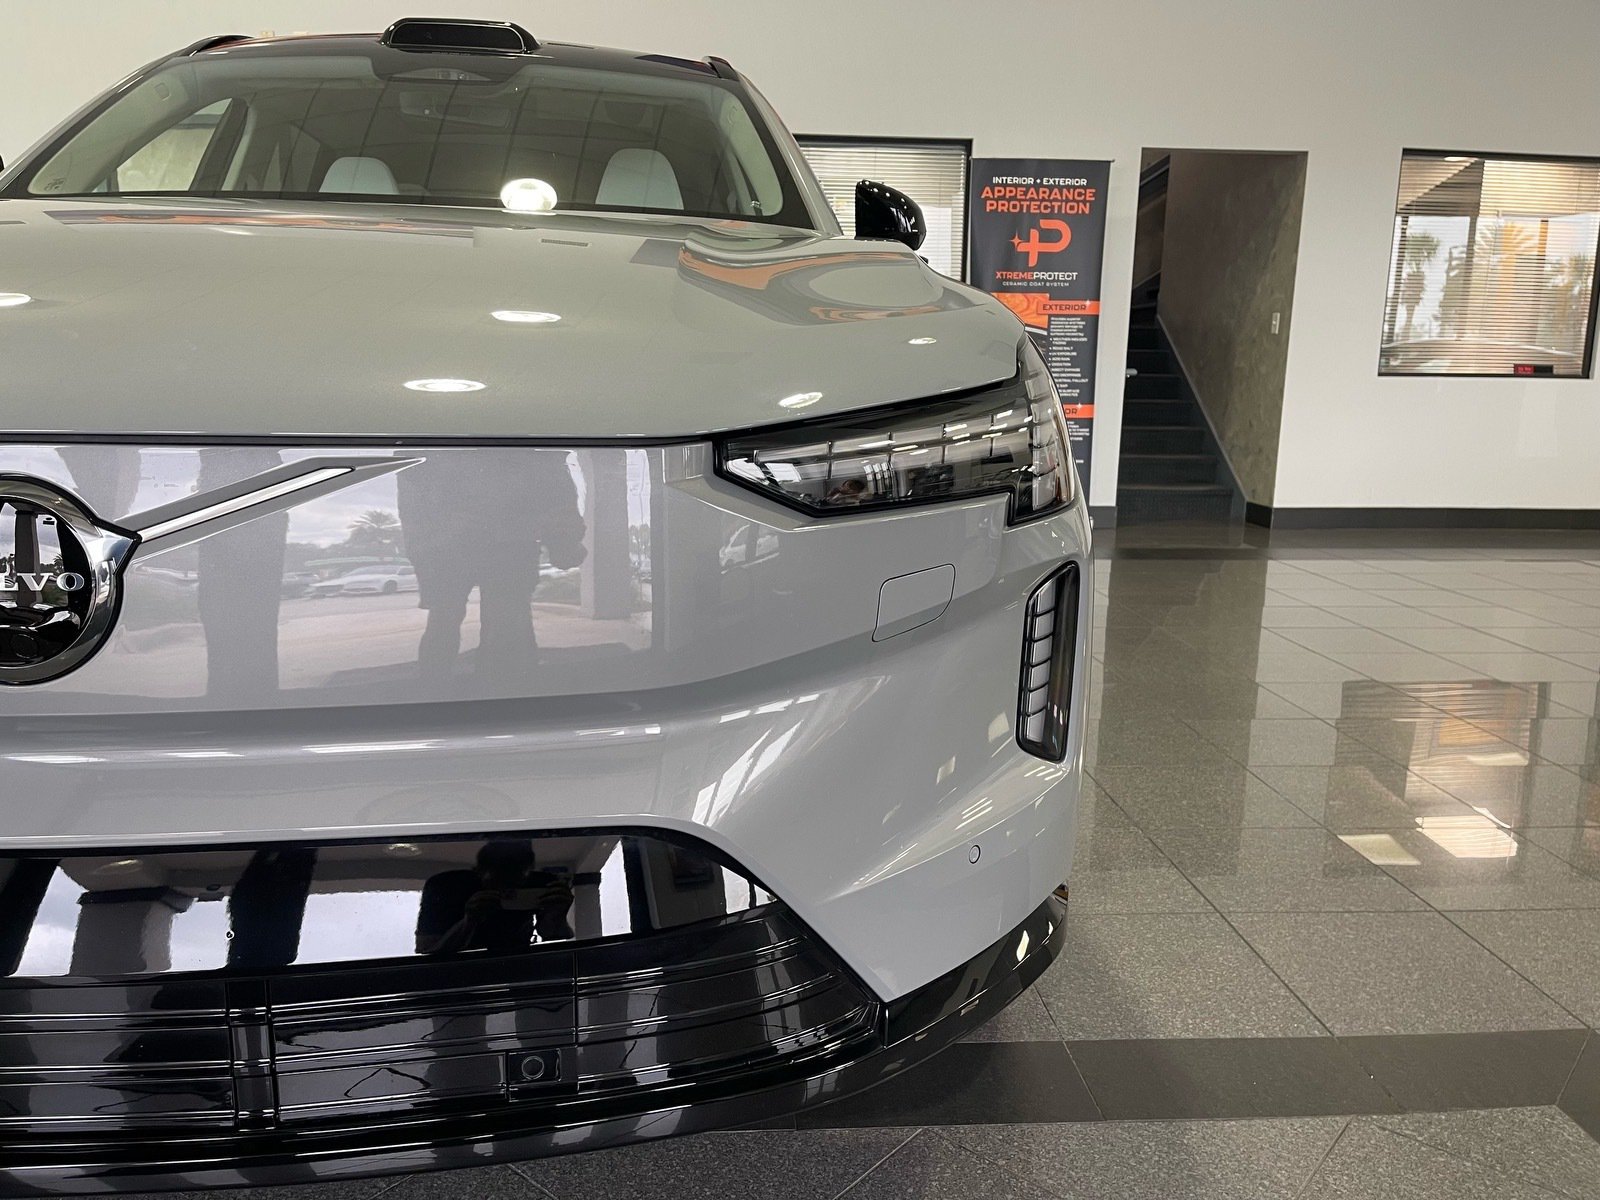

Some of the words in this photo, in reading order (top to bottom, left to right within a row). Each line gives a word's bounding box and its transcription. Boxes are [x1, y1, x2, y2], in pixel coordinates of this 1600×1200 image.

[992, 176, 1034, 185] INTERIOR
[1043, 177, 1087, 186] EXTERIOR
[981, 186, 1096, 201] APPEARANCE
[986, 200, 1090, 214] PROTECTION
[995, 271, 1078, 281] XTREMEPROTECT
[1042, 303, 1087, 311] EXTERIOR
[0, 572, 85, 591] LVO
